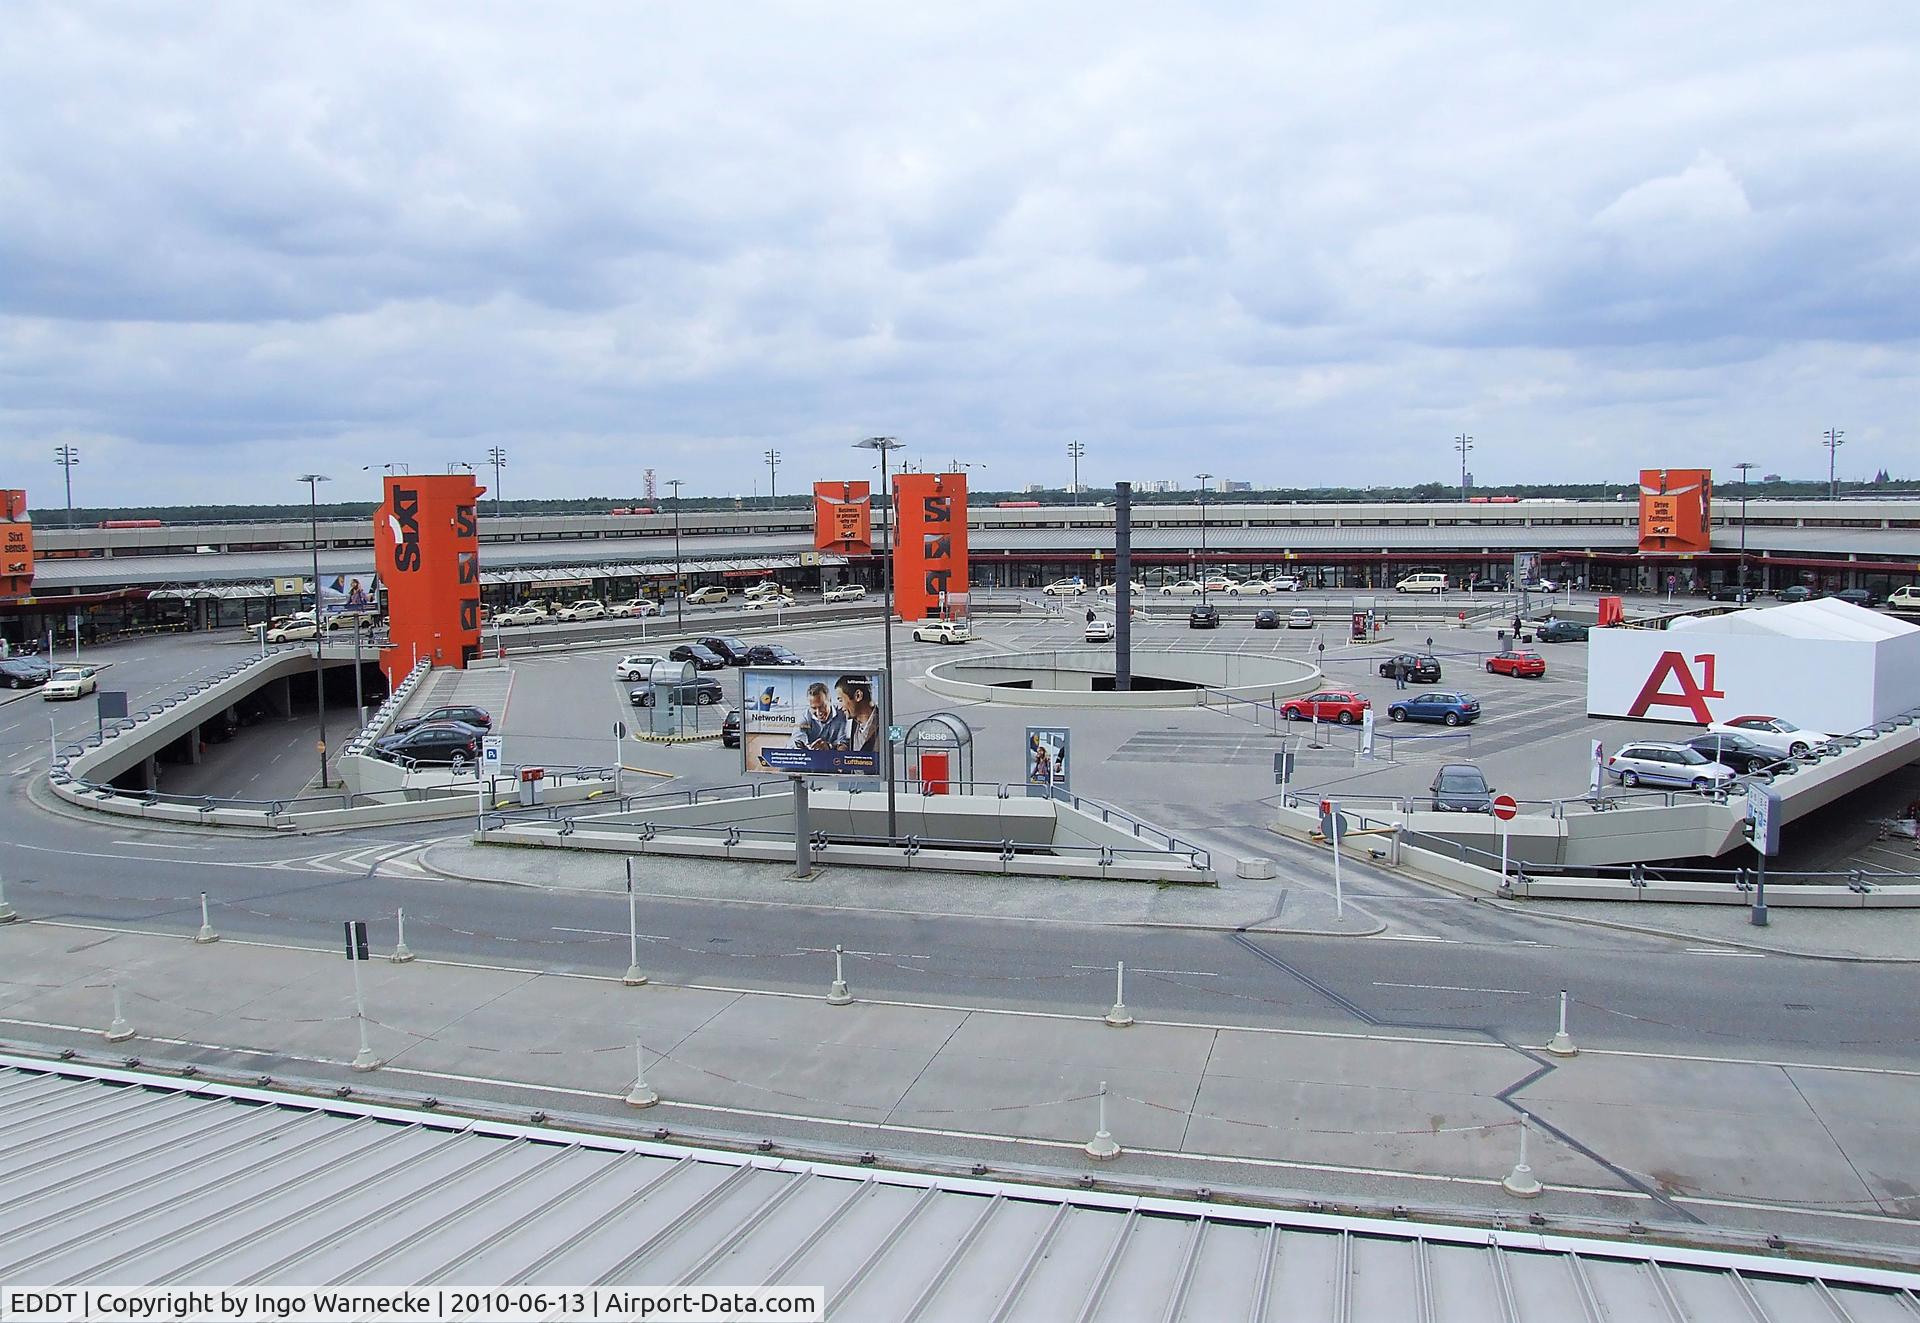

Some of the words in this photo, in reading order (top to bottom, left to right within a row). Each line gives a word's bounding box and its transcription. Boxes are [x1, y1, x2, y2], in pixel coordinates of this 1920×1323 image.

[1654, 501, 1669, 509] Drive
[1626, 651, 1724, 723] A1
[751, 713, 796, 723] Networking
[918, 731, 947, 740] Kasse
